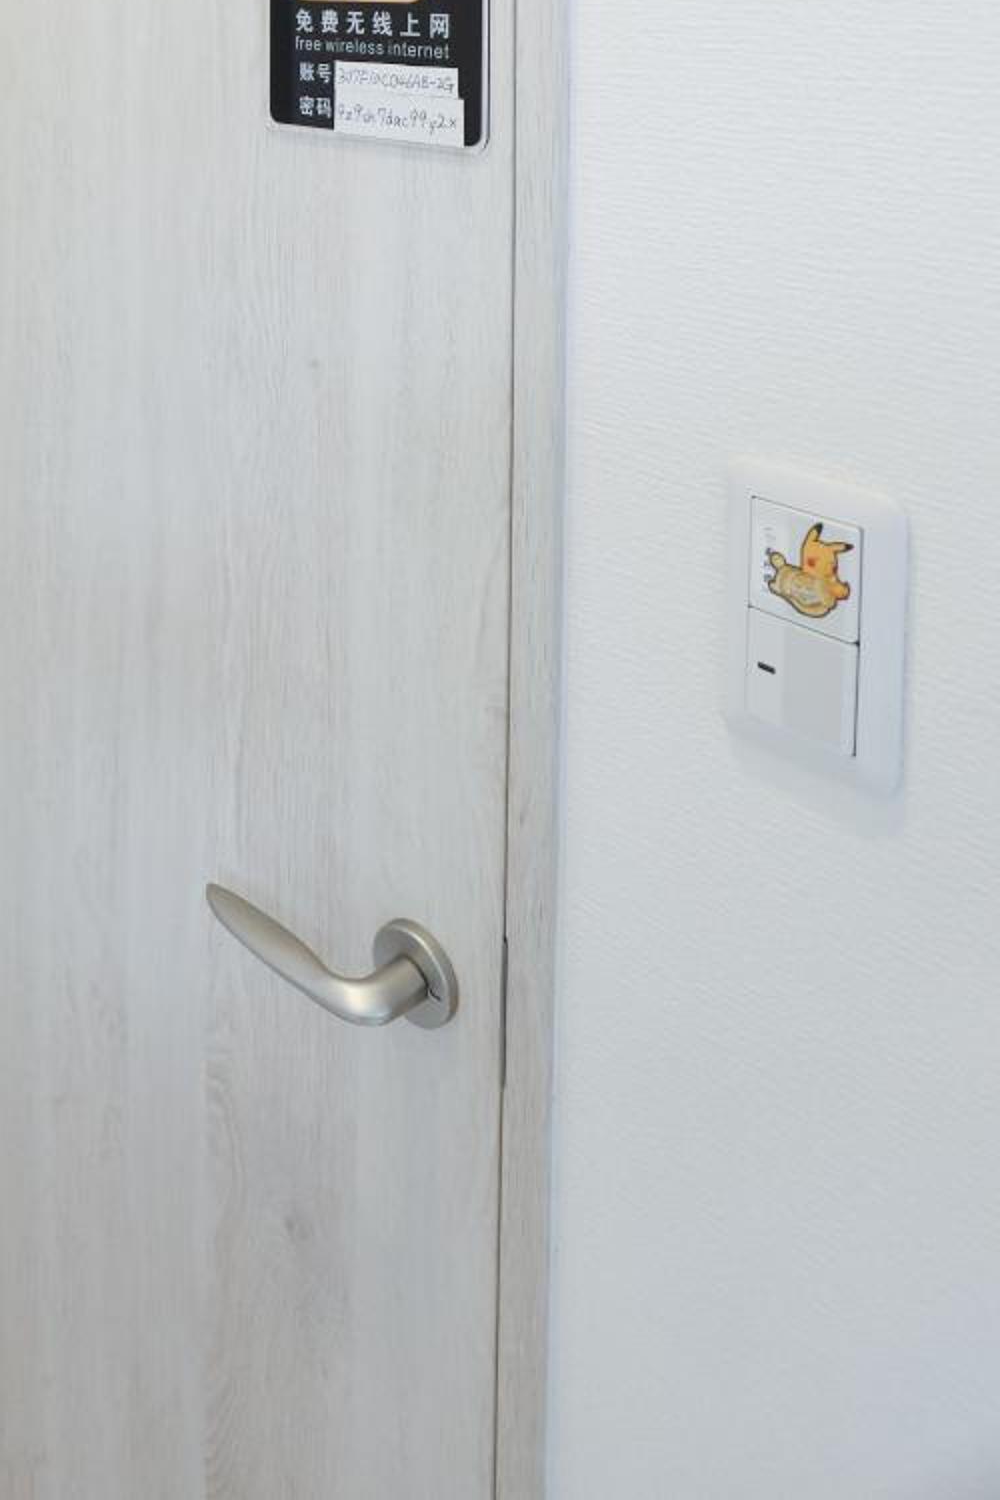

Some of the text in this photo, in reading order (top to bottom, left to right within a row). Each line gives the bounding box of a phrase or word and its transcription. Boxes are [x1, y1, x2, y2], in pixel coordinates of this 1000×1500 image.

[295, 8, 450, 39] 免费无线上网
[295, 35, 450, 60] free wireless internet
[300, 62, 331, 83] 账号
[300, 96, 331, 118] 密码
